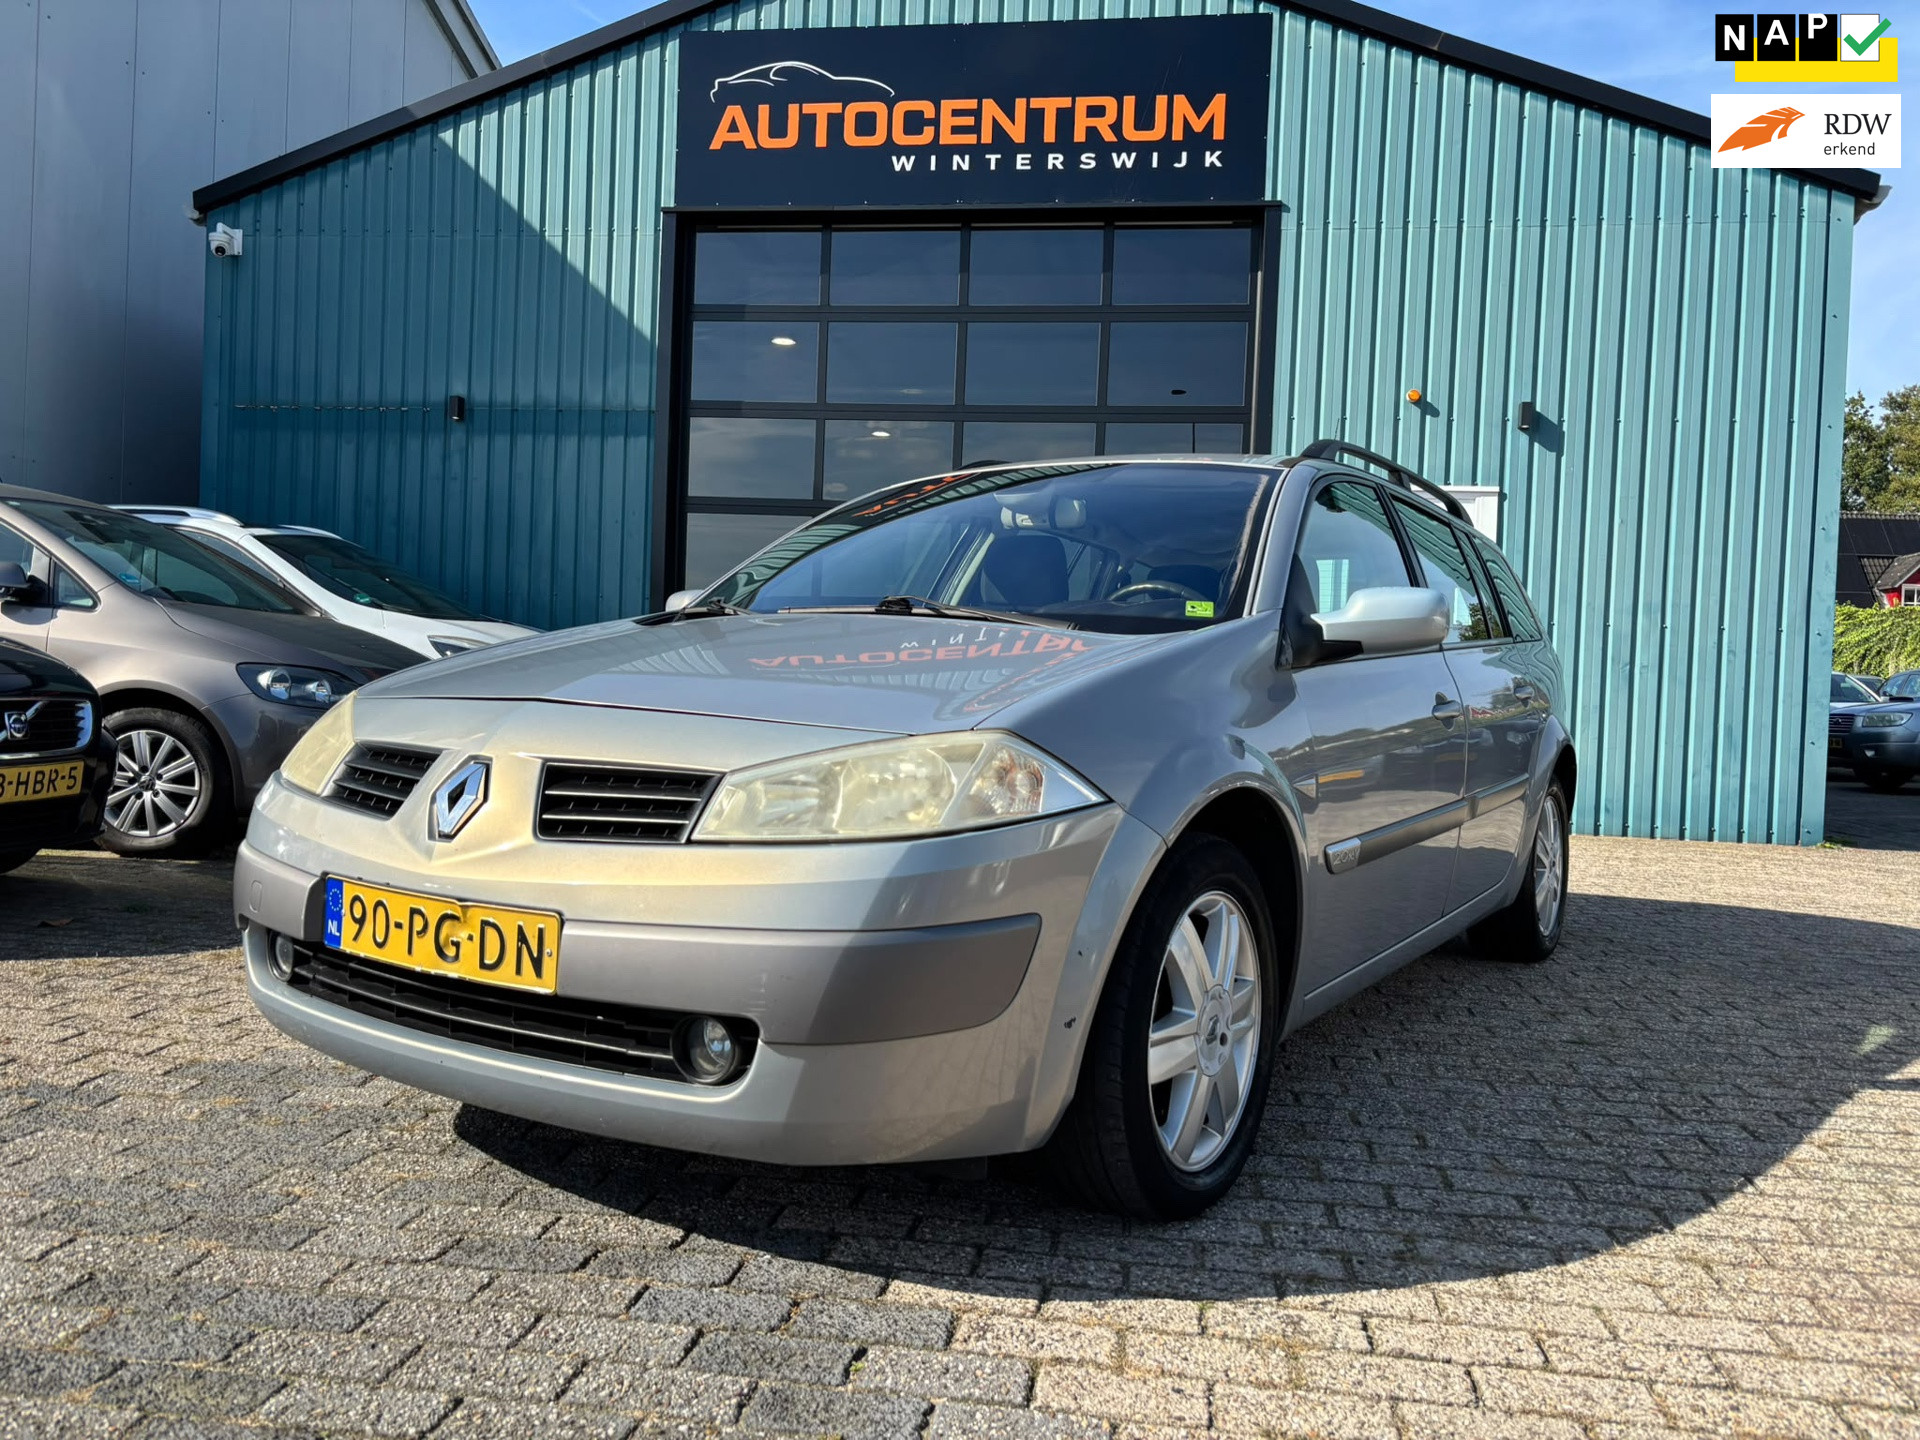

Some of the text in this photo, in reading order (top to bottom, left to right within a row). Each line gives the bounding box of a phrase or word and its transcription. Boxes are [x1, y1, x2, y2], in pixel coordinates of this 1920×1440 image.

[709, 93, 1226, 150] AUTOCENTRUM
[892, 151, 1223, 171] WINTERSWIJK
[328, 920, 340, 936] NL
[349, 894, 545, 979] 90-PG-DN
